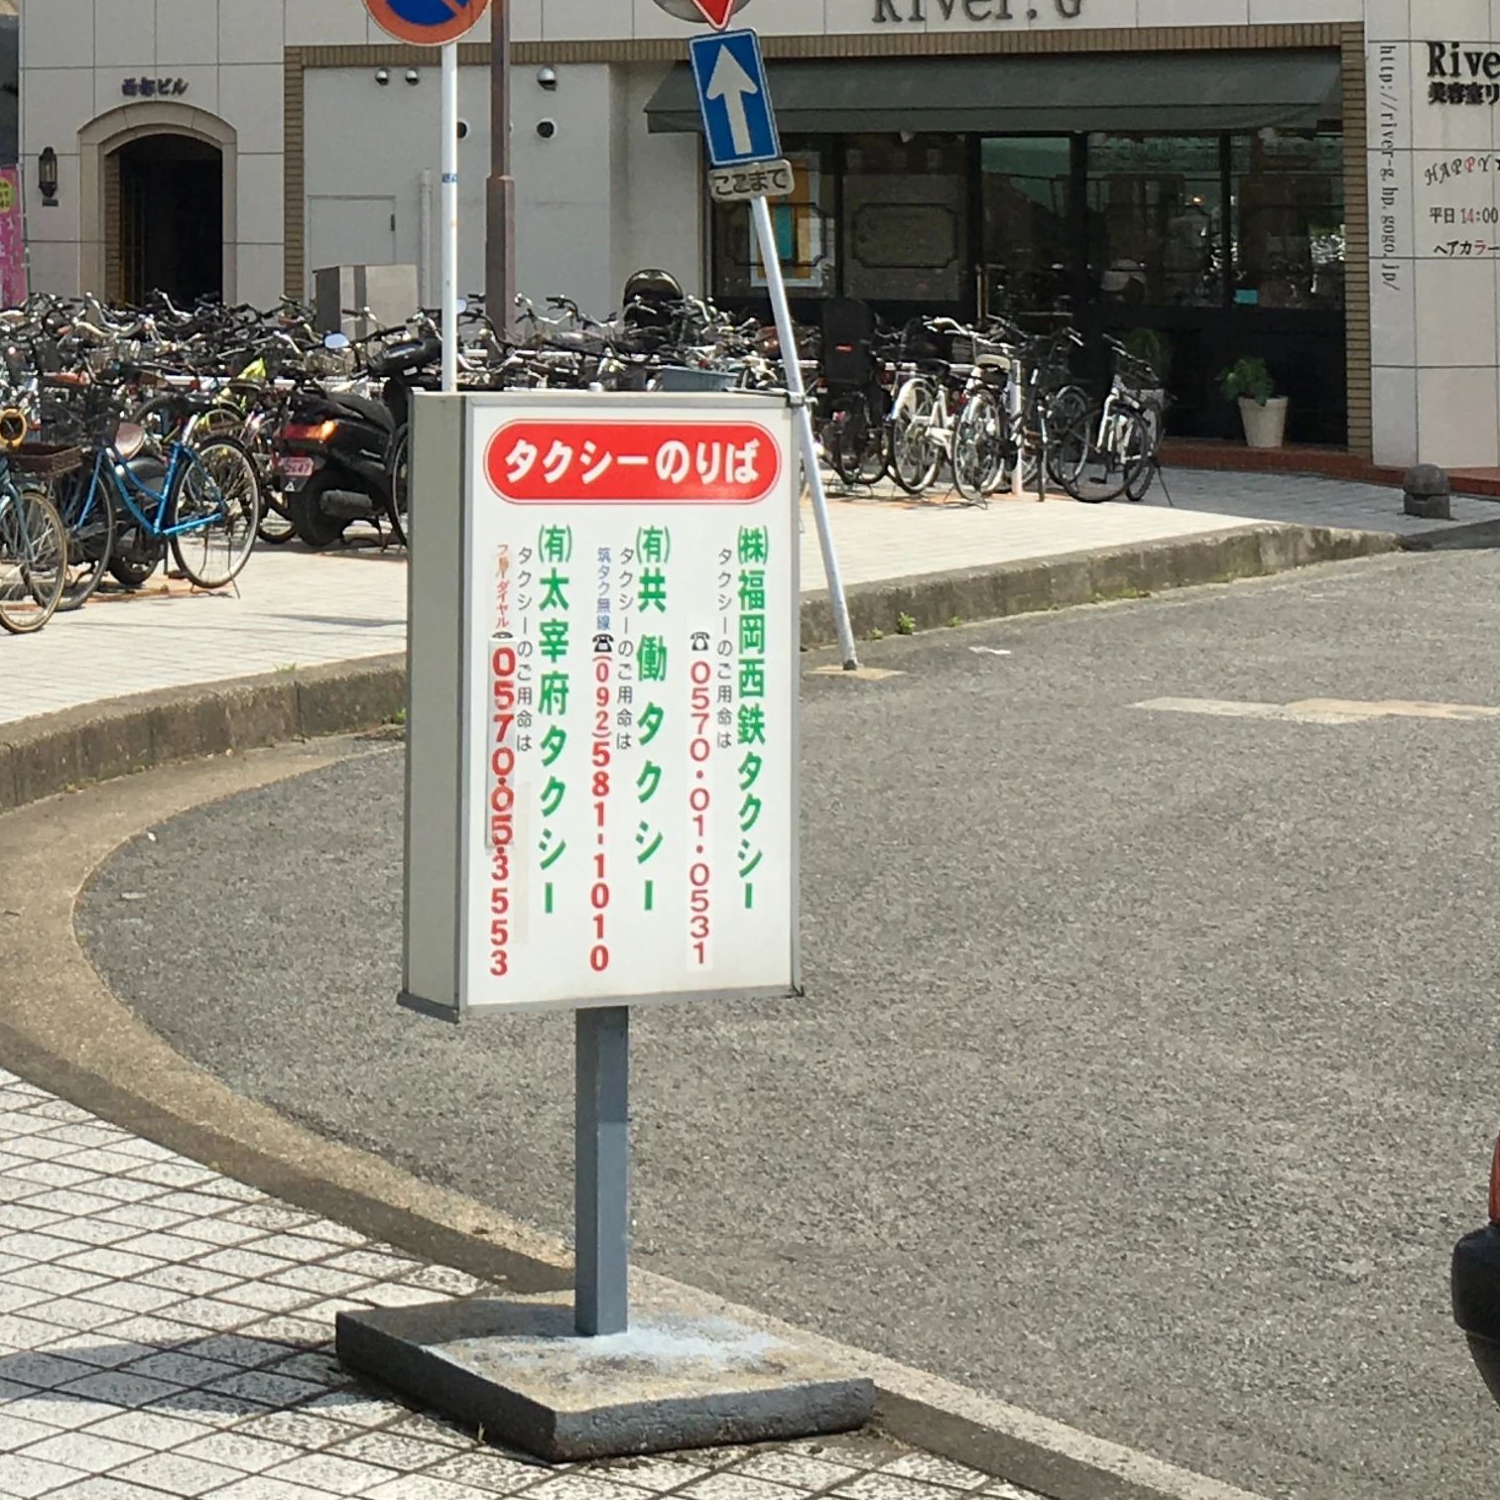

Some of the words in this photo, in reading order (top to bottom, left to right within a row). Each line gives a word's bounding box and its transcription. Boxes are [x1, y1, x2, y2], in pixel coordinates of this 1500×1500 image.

[713, 168, 787, 196] ここまで
[1429, 207, 1455, 224] 平日
[504, 438, 760, 485] タクシーのりば
[516, 547, 533, 752] タクシーのご用命は
[617, 547, 634, 750] タクシーのご用命は
[717, 547, 733, 749] タクシーのご用命は
